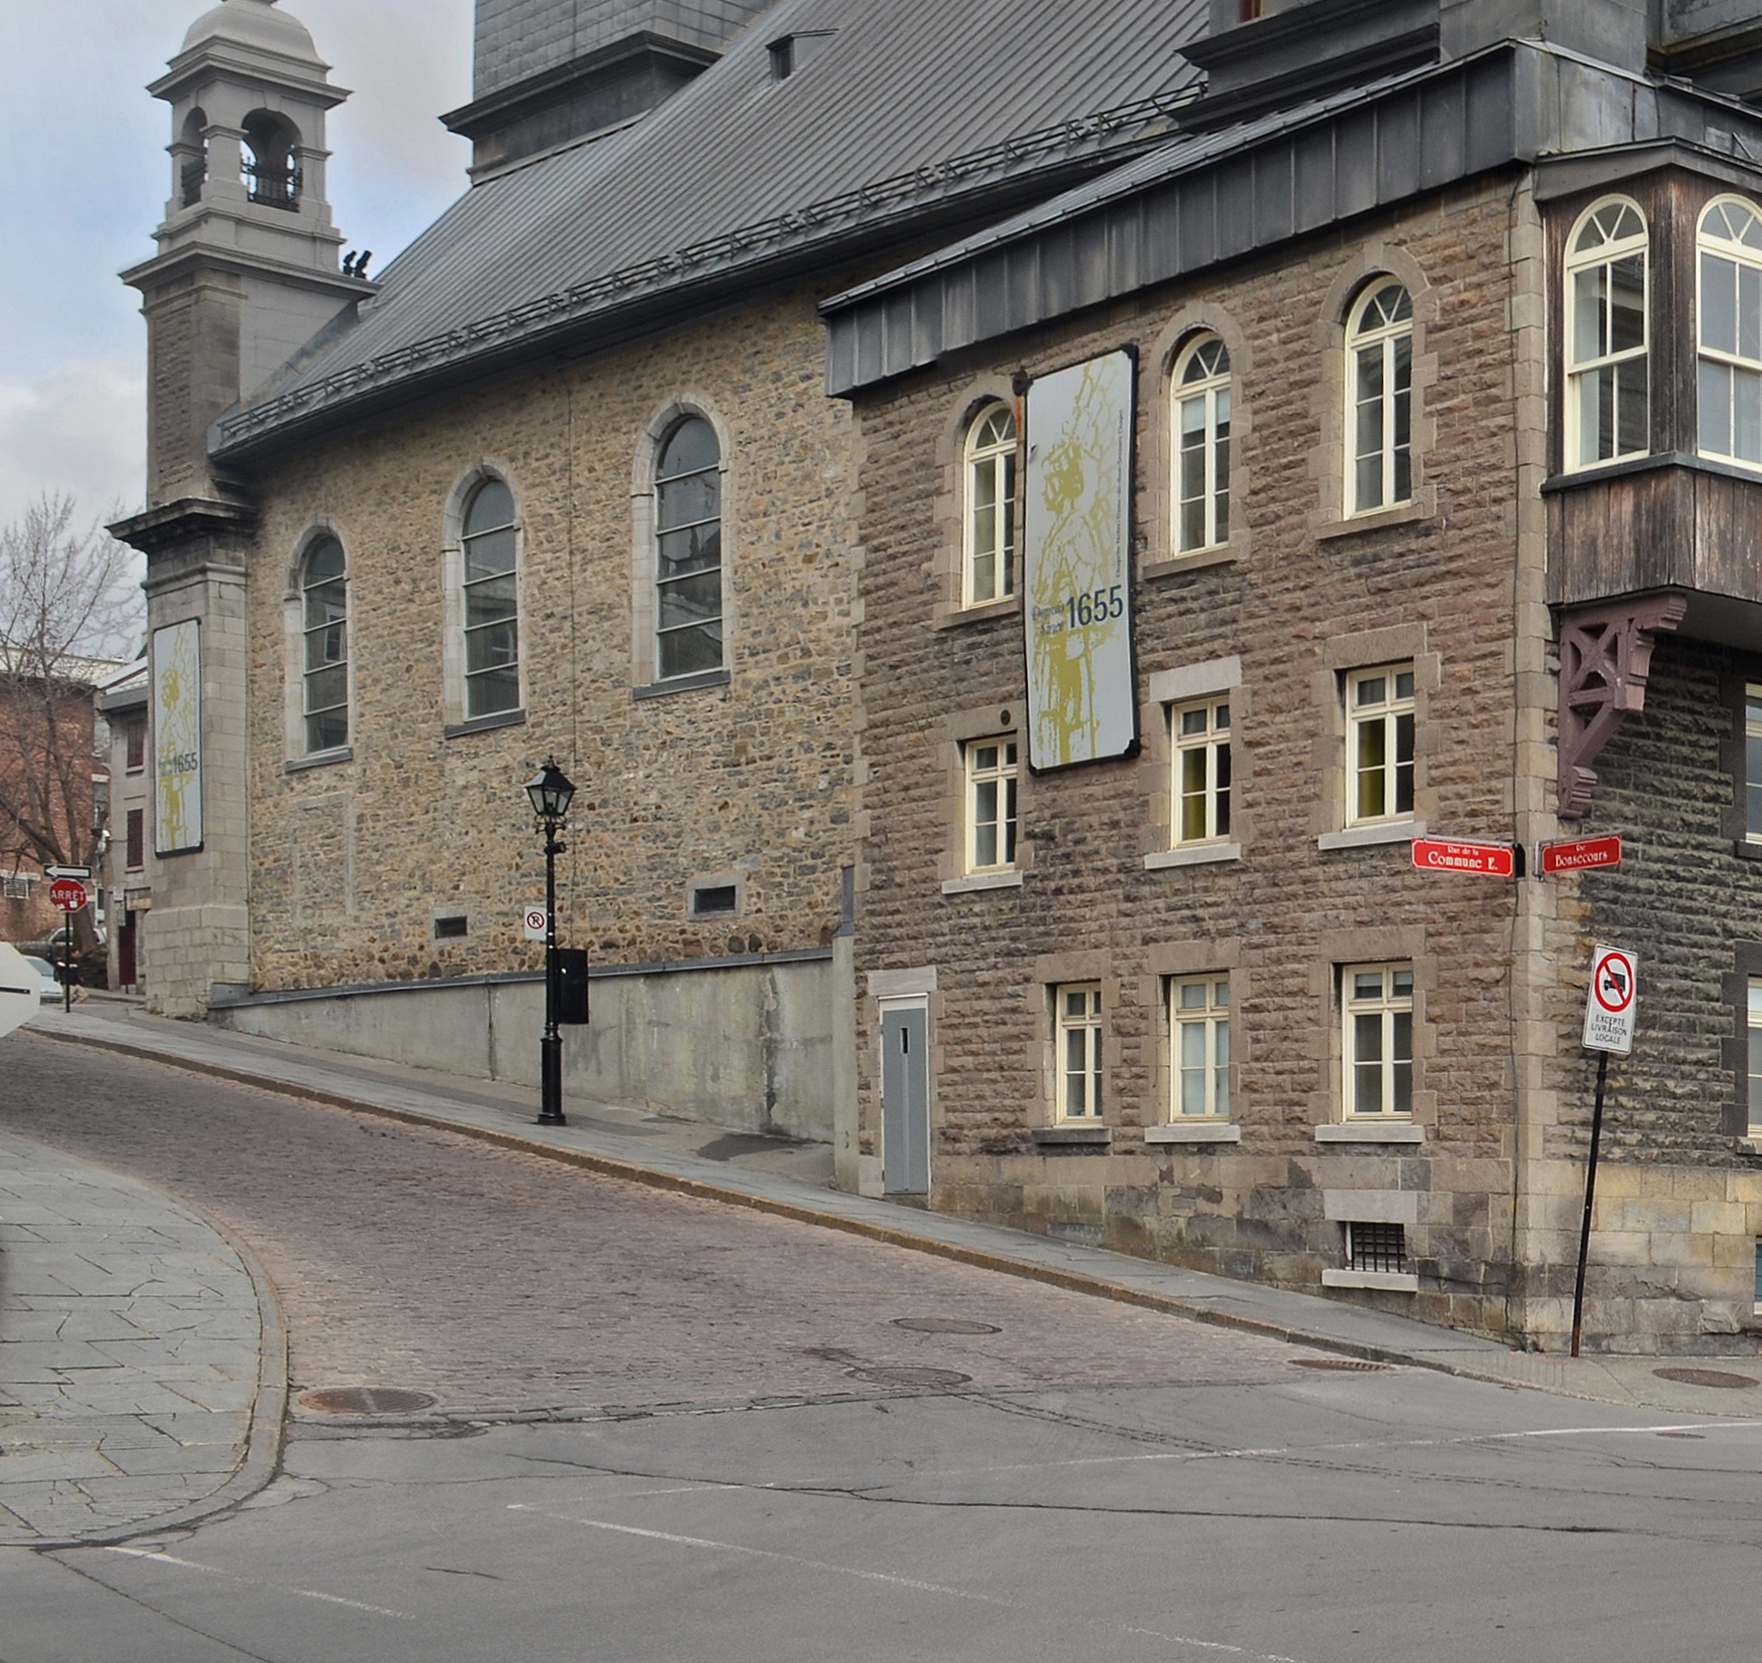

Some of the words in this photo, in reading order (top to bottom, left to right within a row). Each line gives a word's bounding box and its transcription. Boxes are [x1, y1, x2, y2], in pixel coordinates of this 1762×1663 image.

[1066, 584, 1123, 628] 1655
[173, 752, 198, 774] 1655
[1447, 845, 1460, 854] Rue
[1462, 846, 1471, 855] de
[1473, 848, 1479, 856] la
[1428, 851, 1483, 869] Commune
[1488, 857, 1498, 870] E.
[1555, 851, 1608, 867] Bonsecours
[51, 889, 84, 901] ARRÊT
[1591, 1023, 1627, 1036] LIVRAISON
[1595, 1033, 1622, 1044] LOCALE
